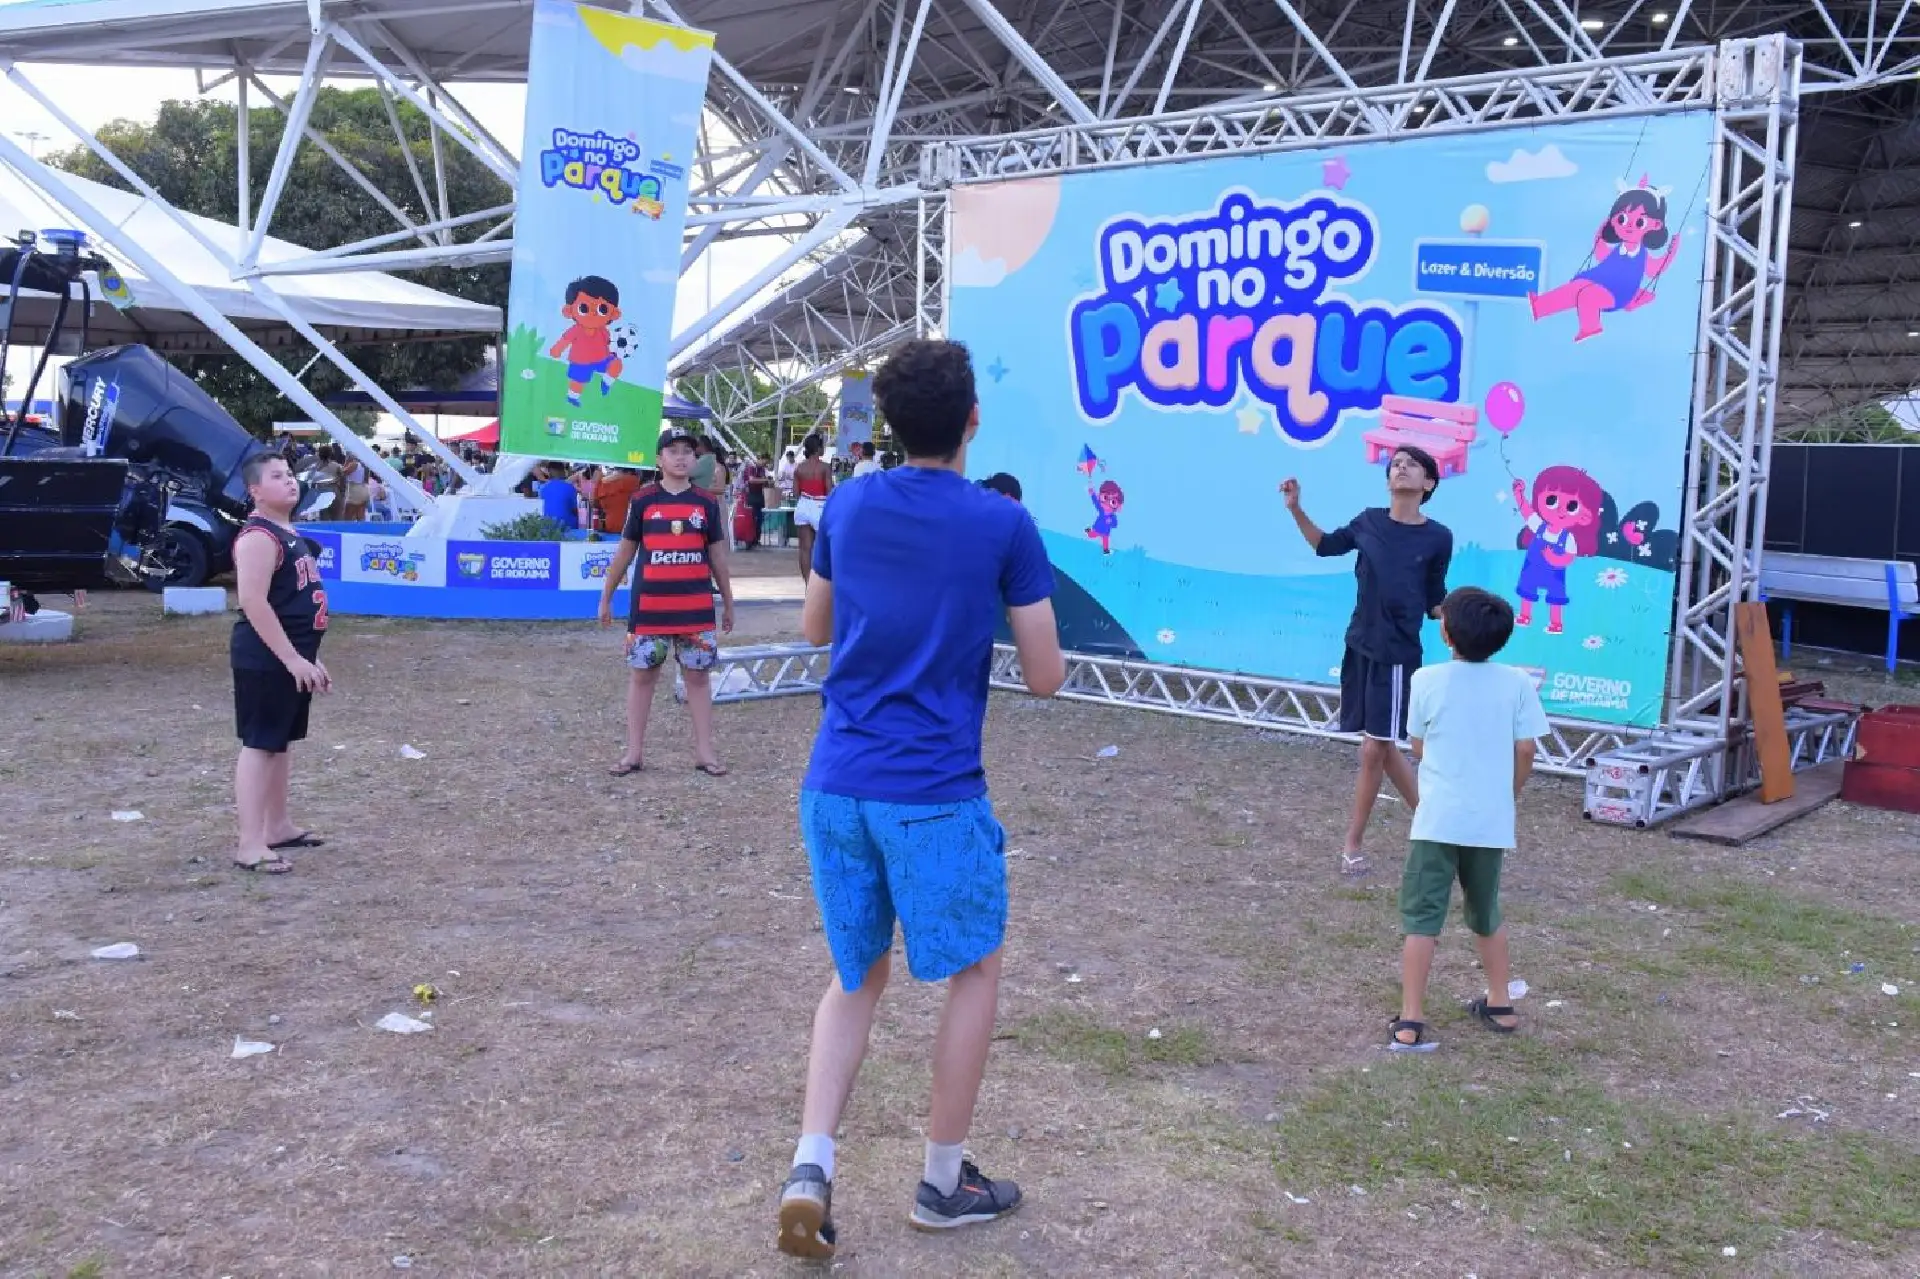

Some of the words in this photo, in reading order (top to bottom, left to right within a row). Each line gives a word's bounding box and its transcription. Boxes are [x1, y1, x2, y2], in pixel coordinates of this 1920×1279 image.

[555, 131, 636, 162] Domingo
[584, 151, 607, 166] no
[543, 152, 659, 200] Parque
[1109, 205, 1363, 289] Domingo
[1421, 260, 1458, 275] Lazer
[1460, 262, 1470, 276] &
[1474, 261, 1535, 281] Diversão
[1197, 266, 1266, 310] no
[1079, 302, 1453, 426] Parque
[571, 420, 619, 435] GOVERNO
[490, 556, 550, 570] GOVERNO
[650, 549, 702, 565] Betano
[490, 569, 504, 579] DE
[506, 569, 550, 580] RORAIMA
[1550, 688, 1568, 701] DE
[1554, 671, 1632, 698] GOVERNO
